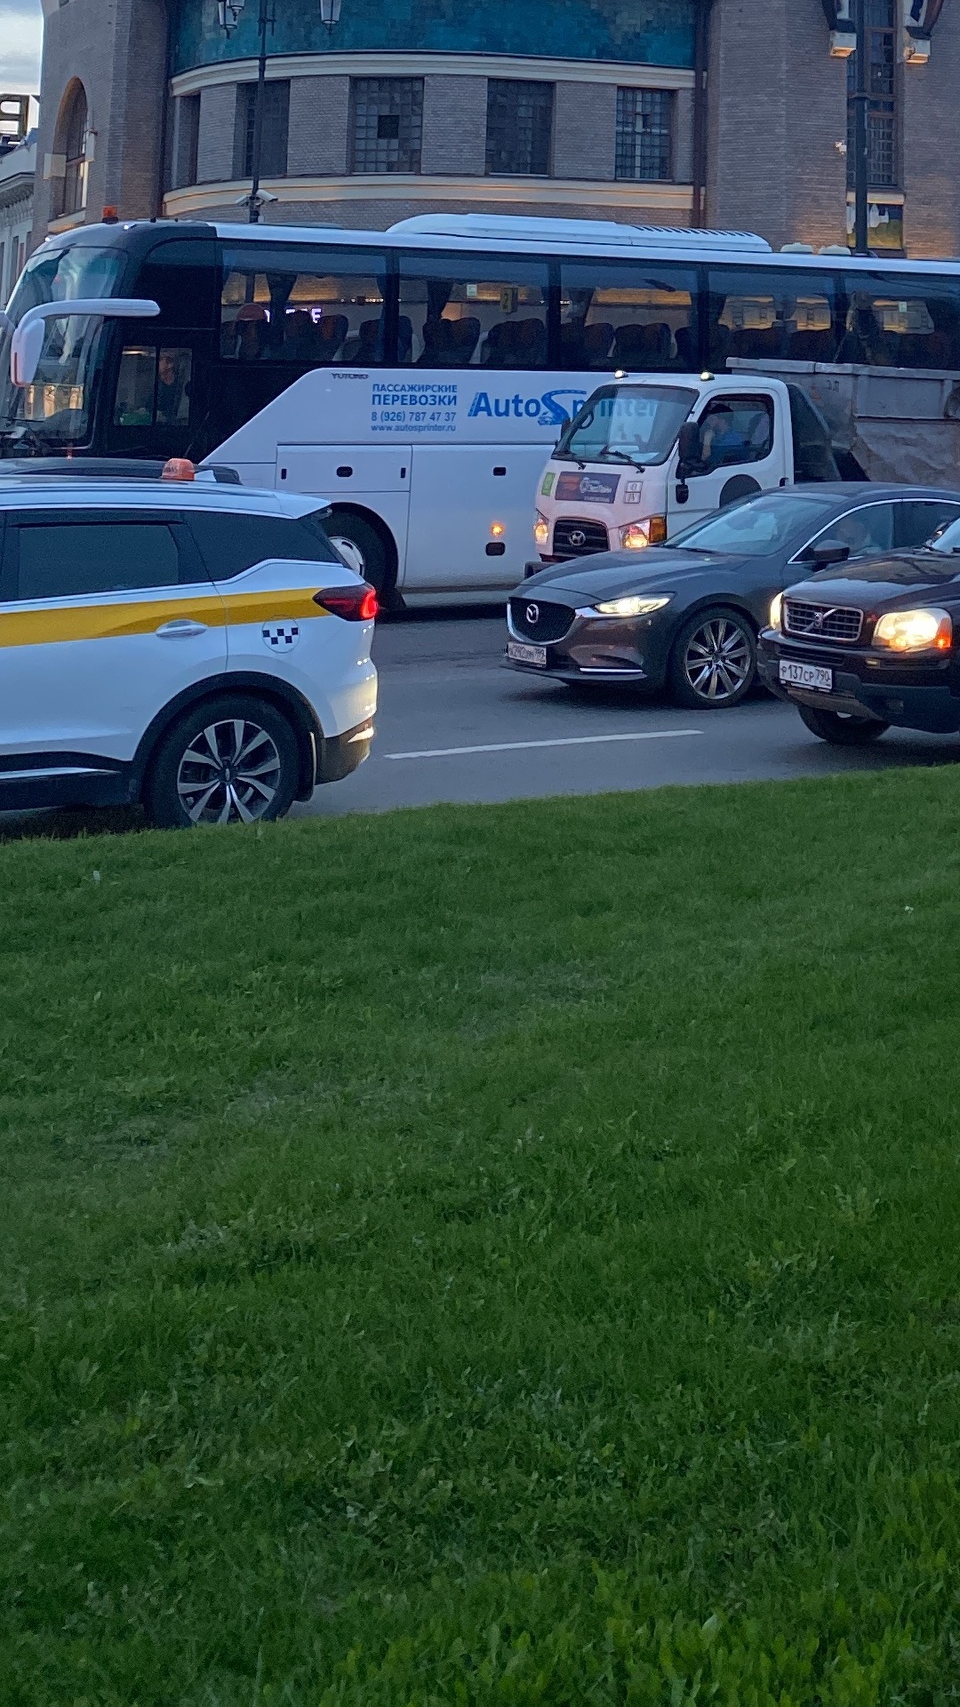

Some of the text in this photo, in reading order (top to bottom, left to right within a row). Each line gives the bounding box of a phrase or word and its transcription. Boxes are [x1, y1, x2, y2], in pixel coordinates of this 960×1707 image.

[372, 383, 458, 393] ПАССАЖИРСКИЕ
[371, 394, 457, 406] ПЕРЕВОЗКИ
[467, 389, 657, 426] AutoSpinter
[371, 410, 457, 423] 8 (926) 787 47 37
[370, 423, 457, 433] www.autosprinter.ru
